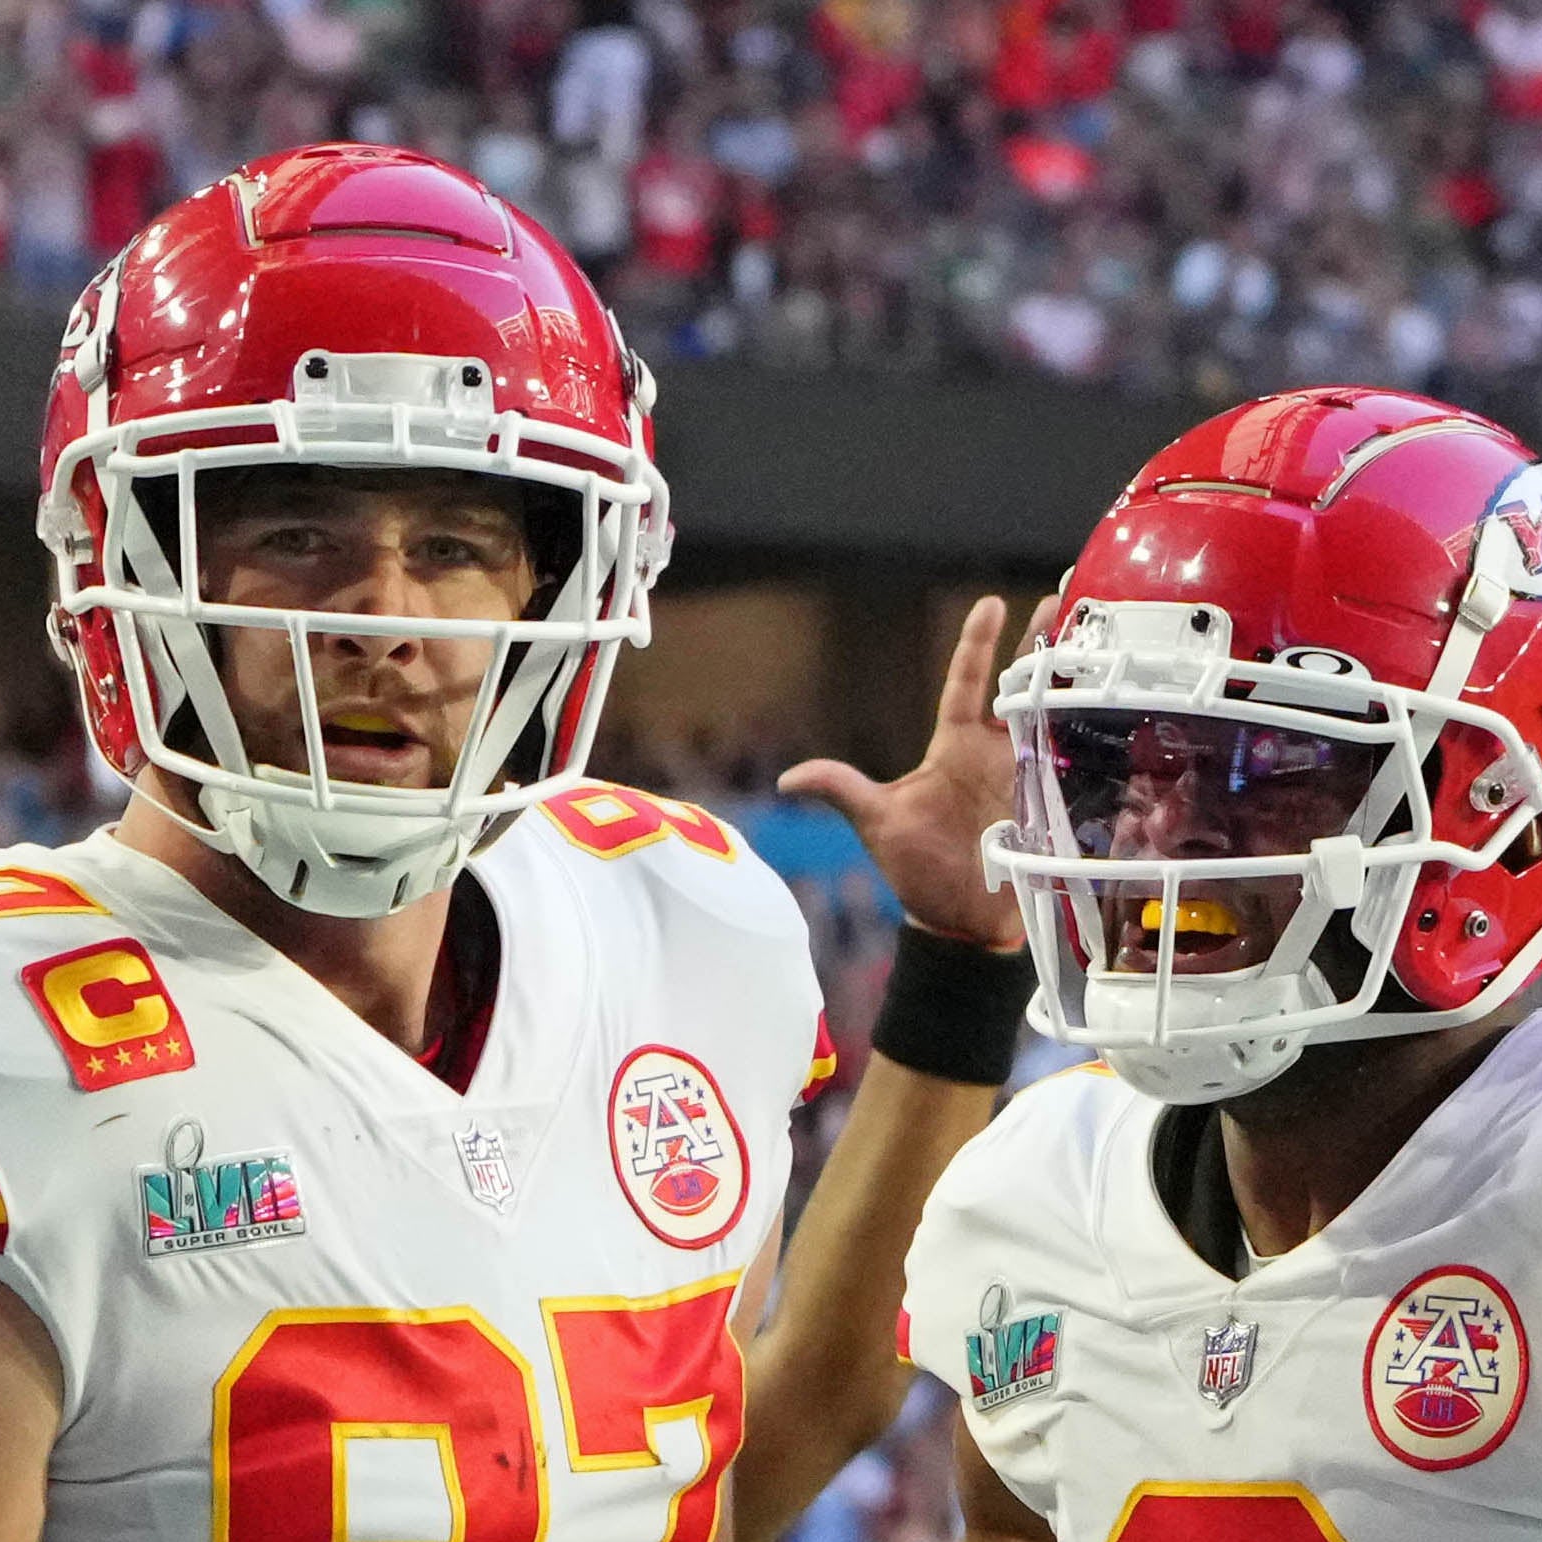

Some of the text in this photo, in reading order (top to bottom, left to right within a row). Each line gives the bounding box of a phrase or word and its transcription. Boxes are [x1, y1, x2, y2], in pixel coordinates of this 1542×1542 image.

[43, 949, 170, 1049] C
[470, 1162, 510, 1195] NFL
[163, 1222, 293, 1250] SUPER BOWL
[1204, 1355, 1241, 1390] NFL
